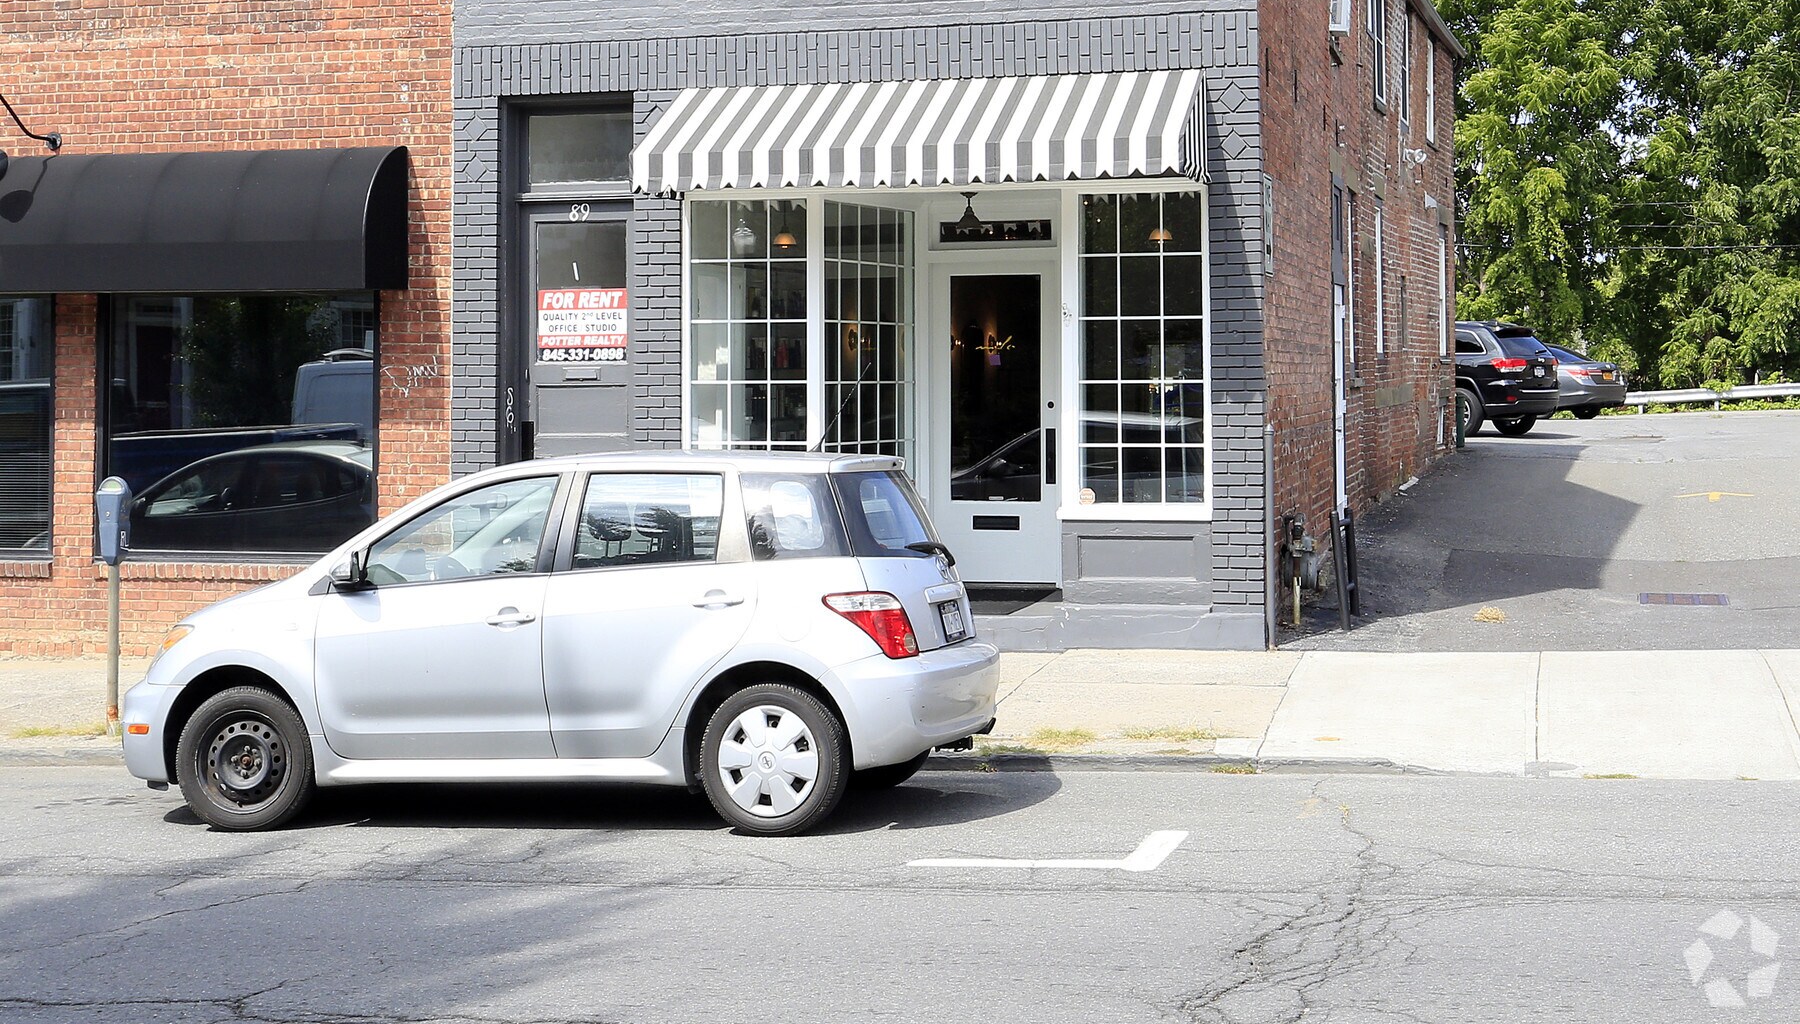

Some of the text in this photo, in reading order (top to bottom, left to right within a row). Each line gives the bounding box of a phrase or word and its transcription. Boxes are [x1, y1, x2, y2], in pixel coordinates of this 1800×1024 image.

[569, 203, 590, 222] 89
[542, 291, 623, 309] FOR RENT
[543, 312, 578, 321] QUALITY
[596, 311, 623, 320] LEVEL
[548, 323, 617, 332] OFFICE STUDIO
[541, 335, 625, 346] POTTER REALTY
[542, 347, 624, 361] 845-331-0898
